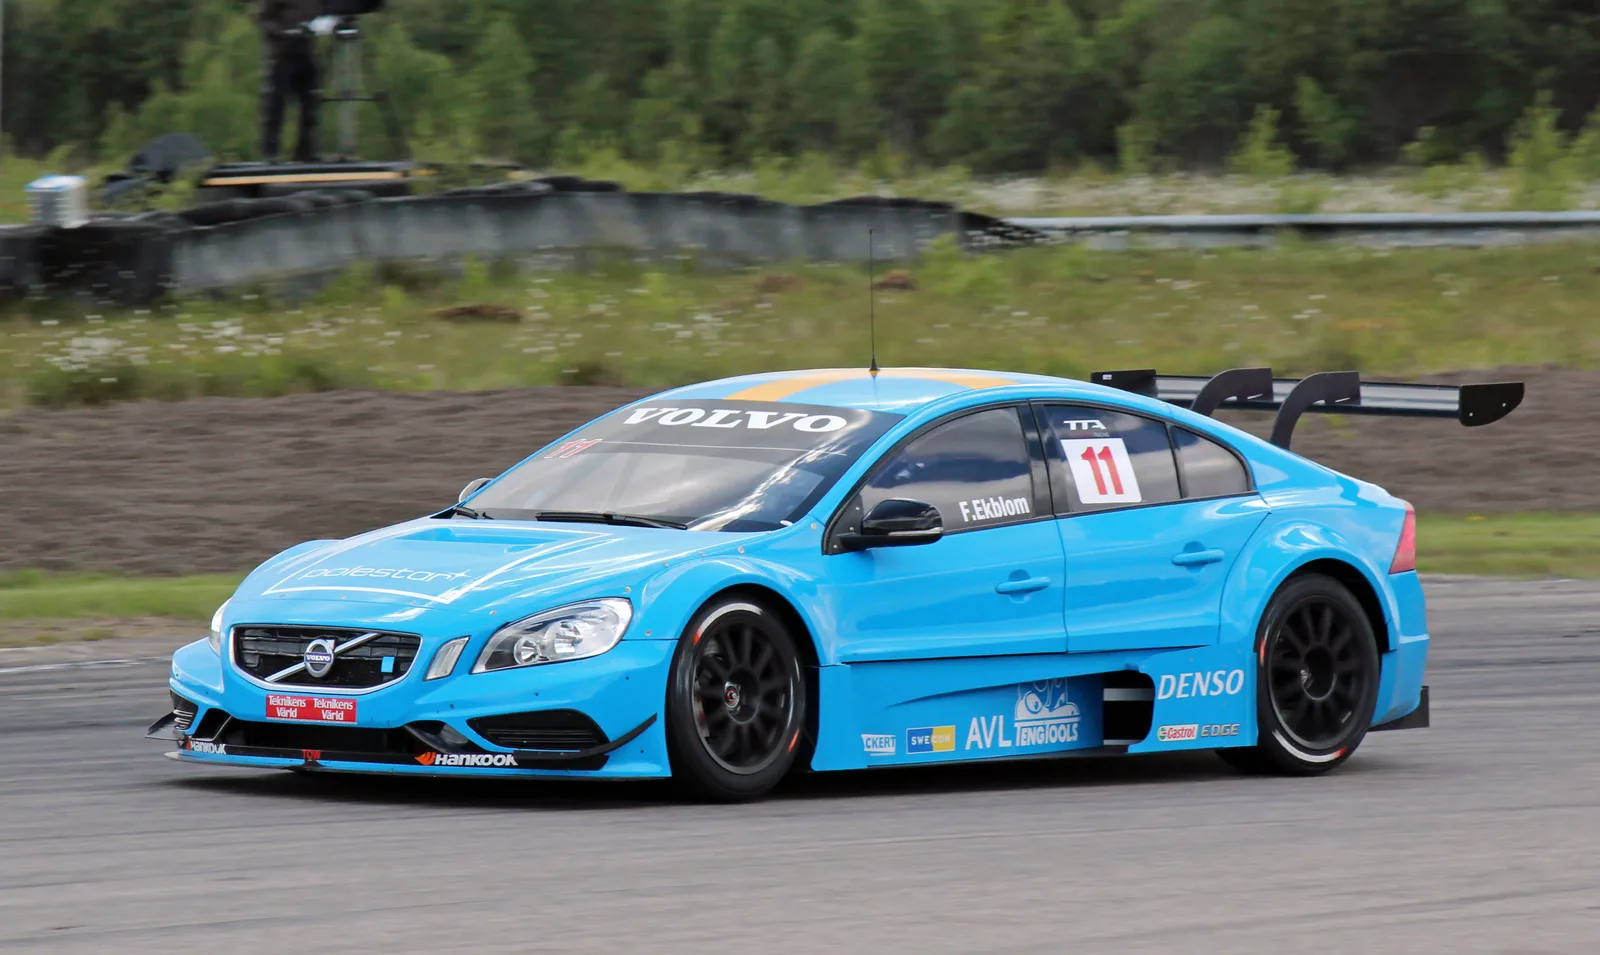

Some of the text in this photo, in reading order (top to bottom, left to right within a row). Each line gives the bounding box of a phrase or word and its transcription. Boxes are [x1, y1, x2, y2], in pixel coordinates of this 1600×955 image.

[623, 407, 847, 432] VOLVO
[1063, 420, 1107, 430] TTA
[1081, 446, 1124, 495] 11
[959, 496, 1030, 522] F.Ekblom
[297, 565, 460, 583] polestar
[306, 654, 331, 662] VOLVO
[1157, 669, 1245, 700] DENSO
[268, 695, 306, 708] Teknikens
[313, 698, 353, 710] Teknikens
[276, 706, 298, 718] Värld
[322, 709, 344, 721] Värld
[965, 715, 1013, 750] AVL
[1166, 723, 1241, 740] Castrol EDGE
[911, 734, 951, 746] SWECON
[302, 749, 321, 760] TOW
